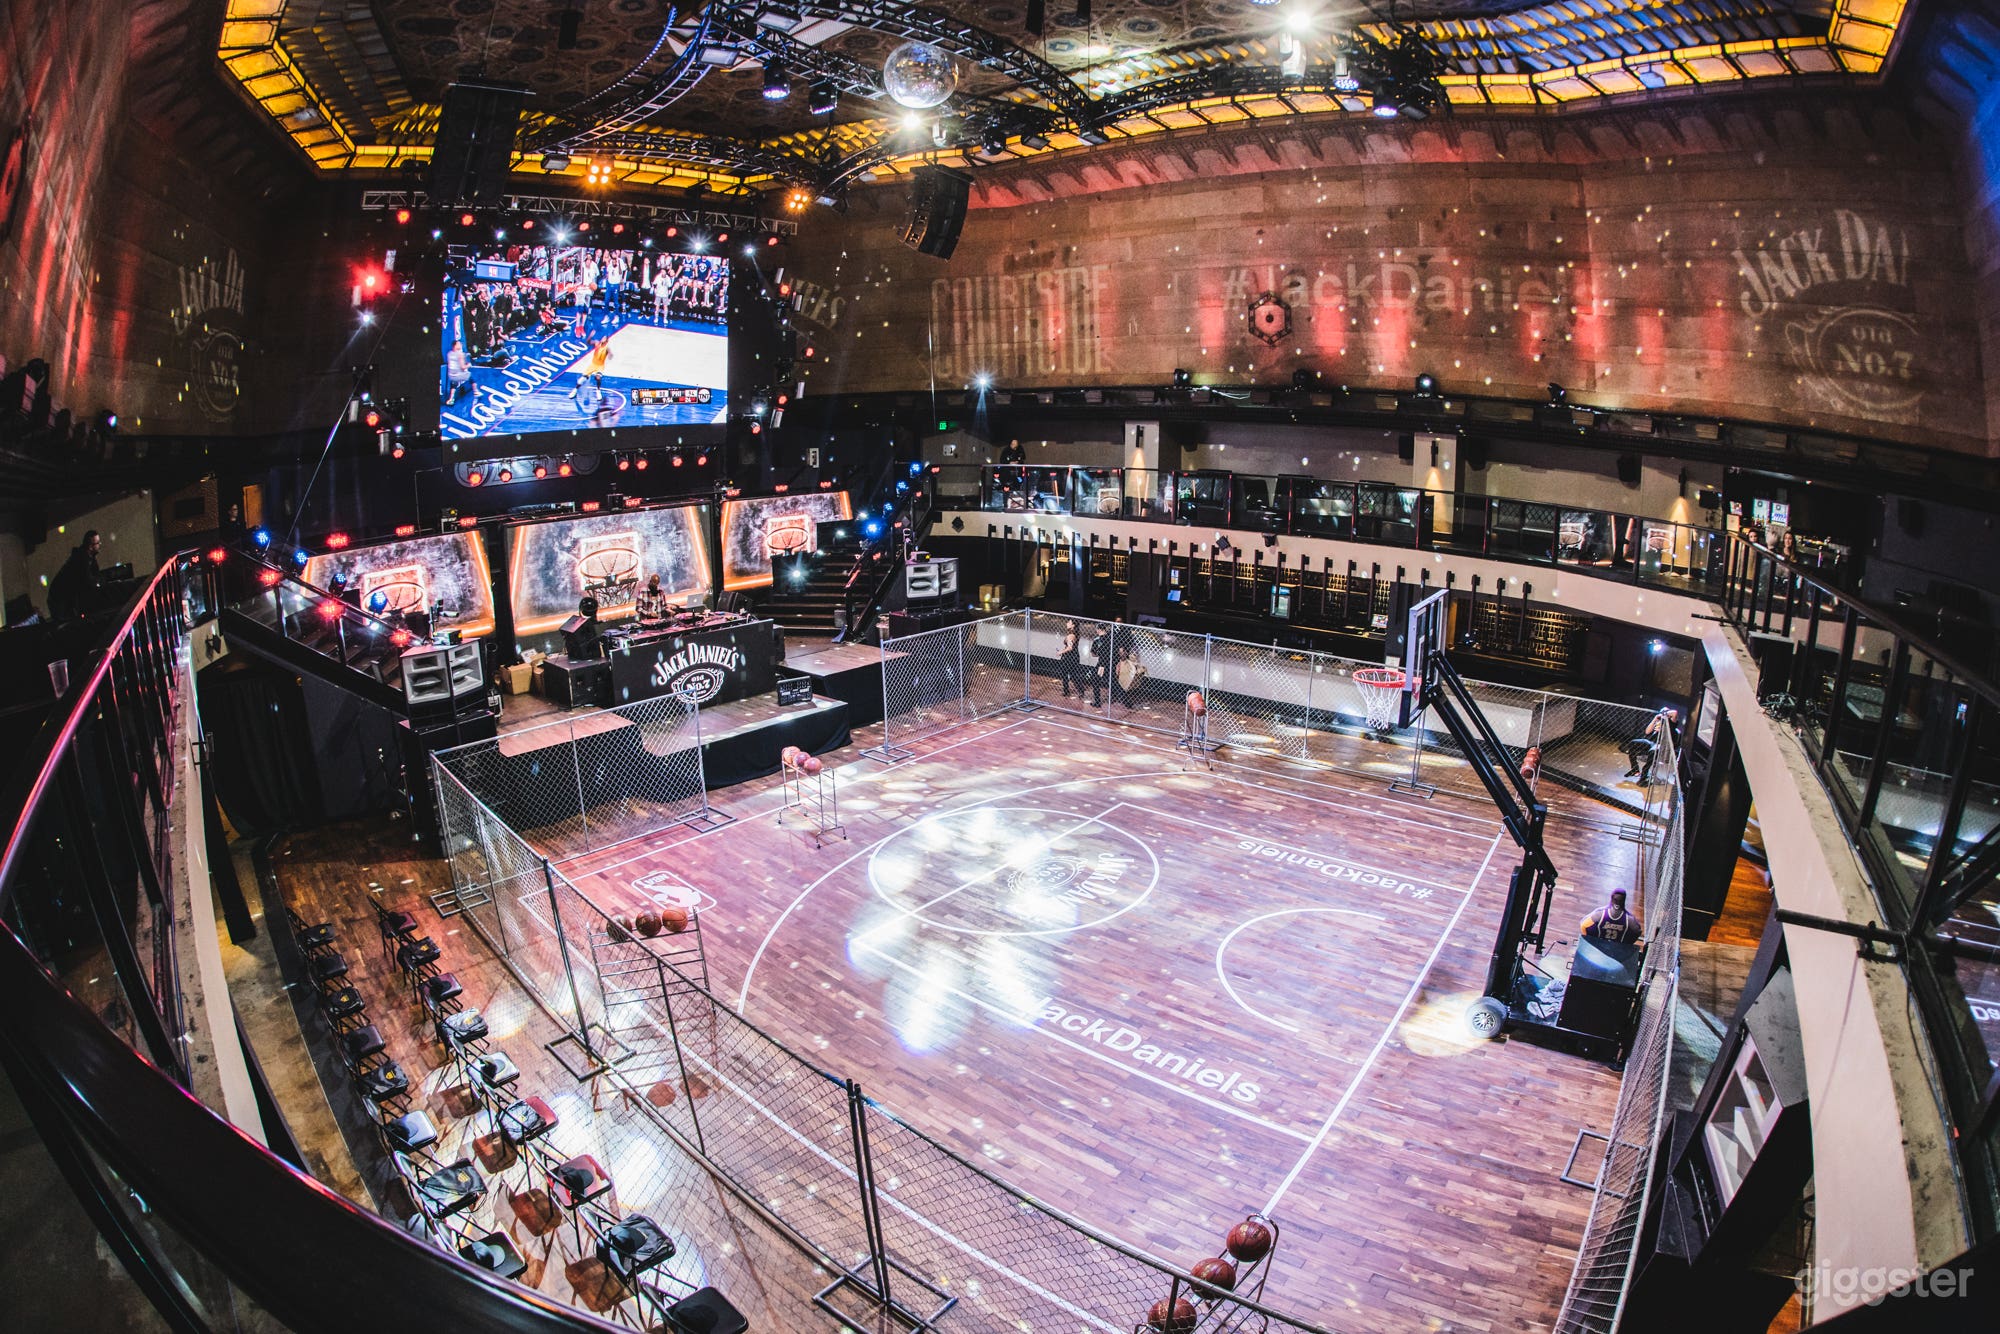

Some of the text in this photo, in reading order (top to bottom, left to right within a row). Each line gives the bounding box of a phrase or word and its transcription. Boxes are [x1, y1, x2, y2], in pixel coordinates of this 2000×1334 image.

[173, 260, 222, 337] JACK
[1732, 228, 1839, 318] JACK
[653, 642, 740, 685] JACK DANIEL'S
[1237, 840, 1434, 900] #JackDaniels
